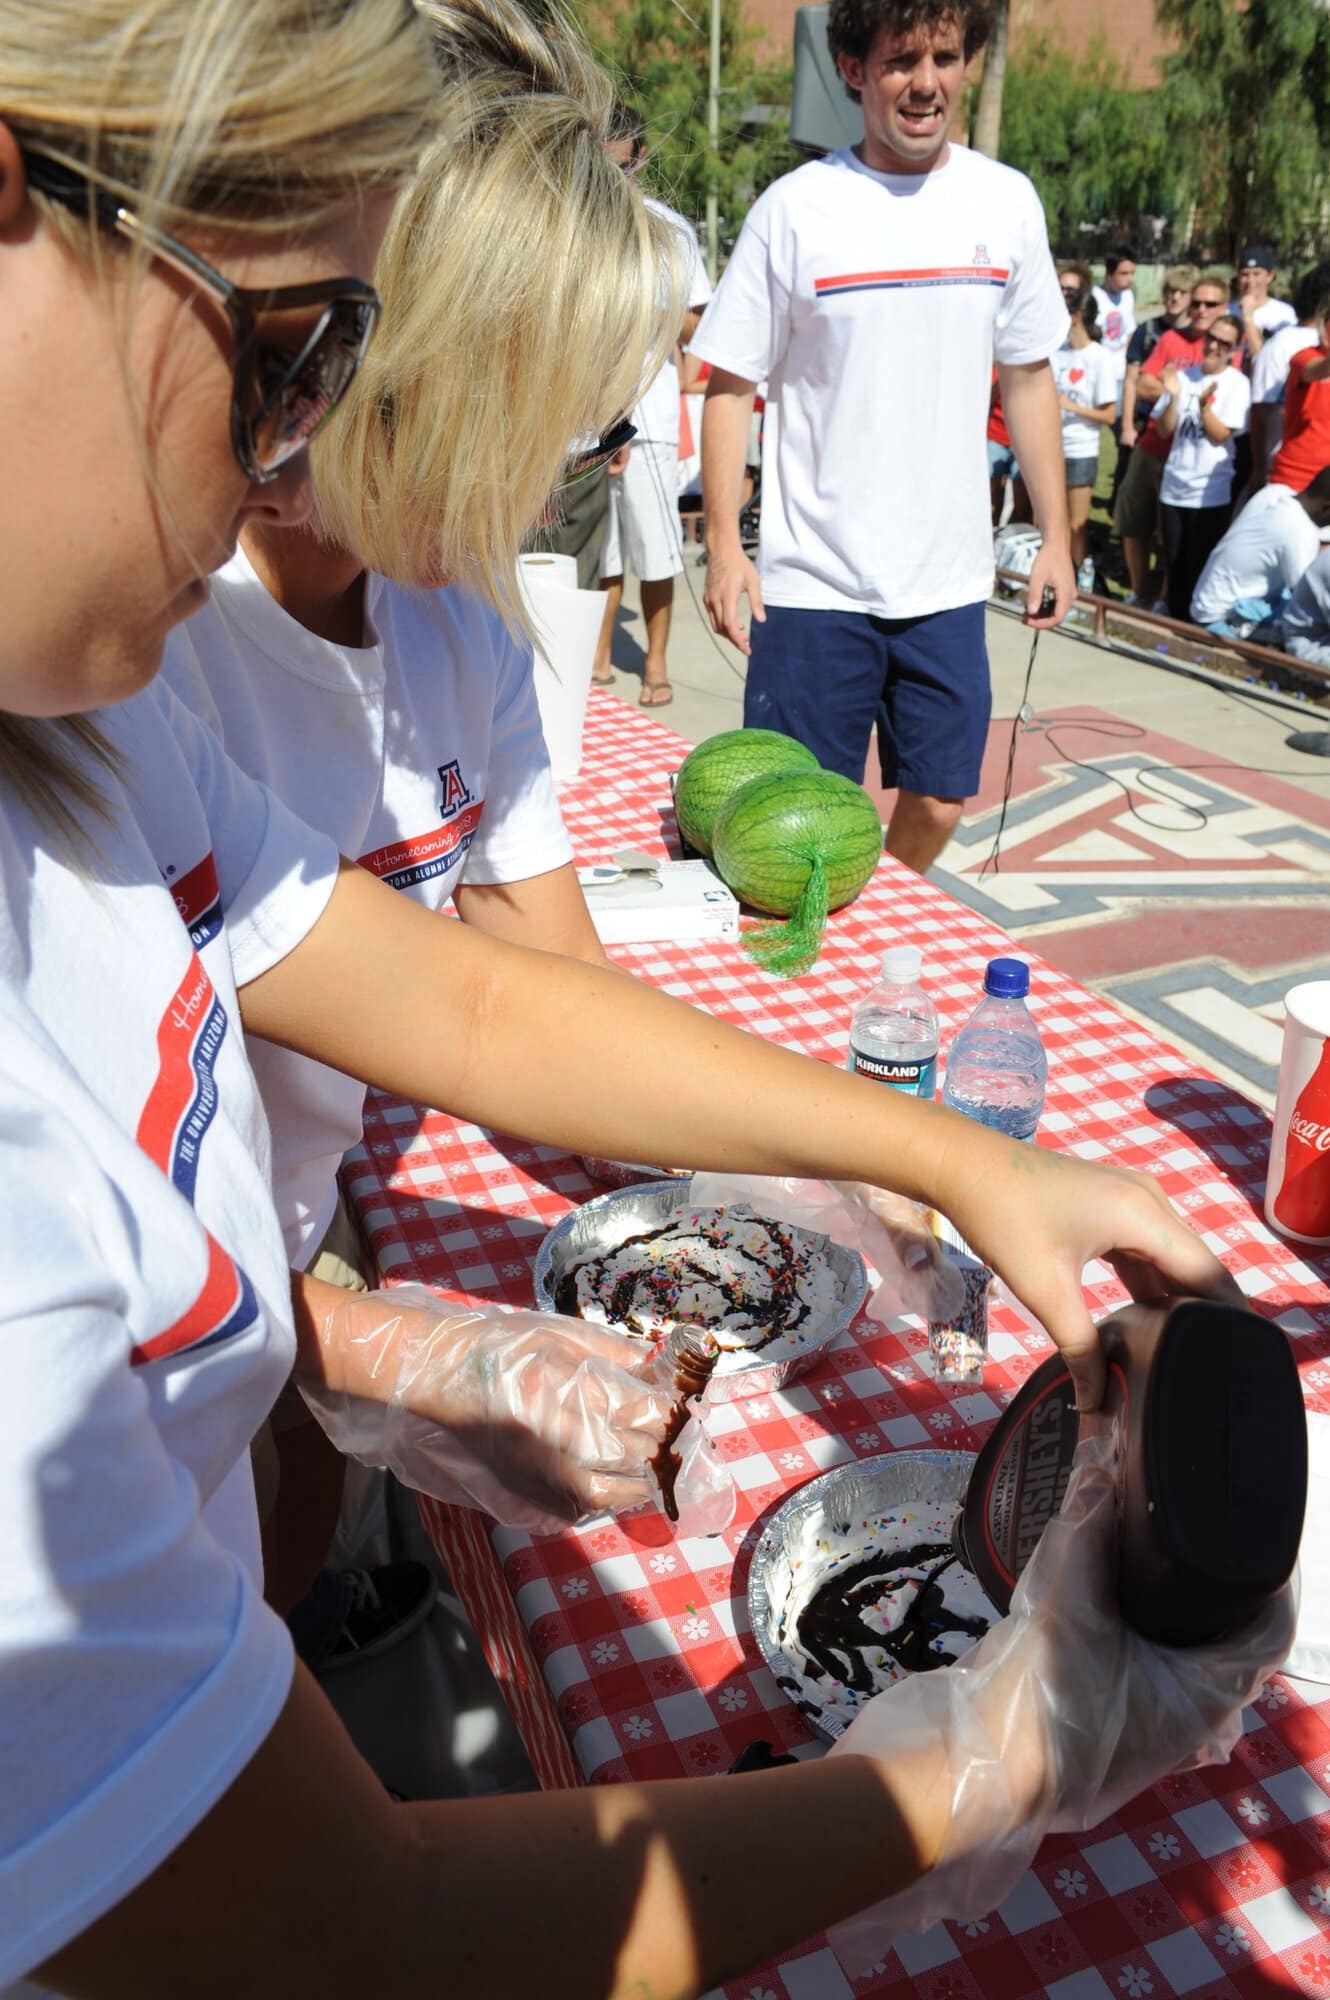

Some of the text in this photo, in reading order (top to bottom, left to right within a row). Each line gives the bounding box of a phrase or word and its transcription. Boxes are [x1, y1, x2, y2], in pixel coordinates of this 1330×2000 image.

[438, 758, 470, 819] A
[373, 832, 455, 871] Homecoming
[415, 861, 446, 880] ALUMNI
[179, 1137, 196, 1164] THE
[202, 1008, 226, 1061] ARIZONA
[855, 1057, 920, 1078] KIRKLAND
[993, 1460, 1009, 1543] GENUINE
[1002, 1438, 1021, 1557] CHOCOLATE FLAVOR
